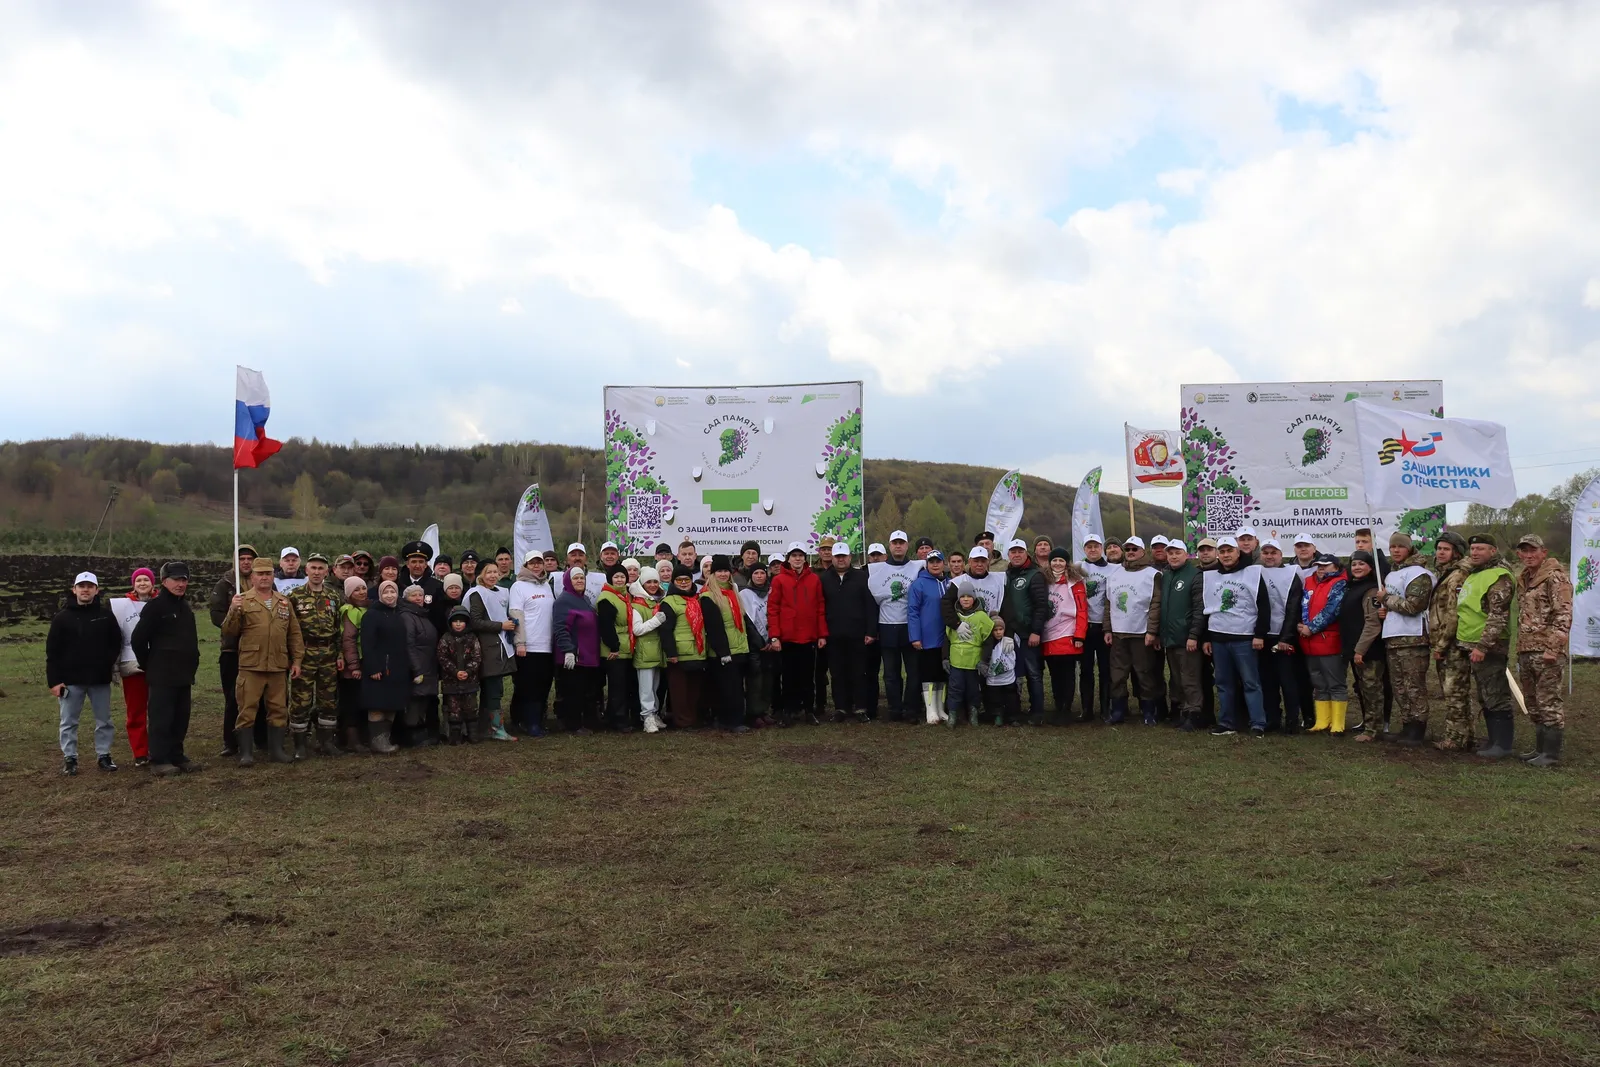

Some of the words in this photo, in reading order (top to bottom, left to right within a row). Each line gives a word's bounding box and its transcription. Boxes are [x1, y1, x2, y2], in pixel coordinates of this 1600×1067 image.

[703, 418, 721, 434] САД
[722, 414, 760, 435] ПАМЯТИ
[1286, 417, 1304, 434] САД
[1305, 413, 1343, 434] ПАМЯТИ
[1401, 460, 1490, 478] ЗАЩИТНИКИ
[1401, 474, 1481, 490] ОТЕЧЕСТВА
[1288, 489, 1308, 498] ЛЕС
[1310, 488, 1346, 497] ГЕРОЕВ
[1293, 508, 1299, 516] В
[1302, 508, 1342, 516] ПАМЯТЬ
[686, 526, 738, 534] ЗАЩИТНИКЕ
[740, 525, 789, 533] ОТЕЧЕСТВА
[1252, 519, 1260, 527] О
[1262, 518, 1329, 528] ЗАЩИТНИКАХ
